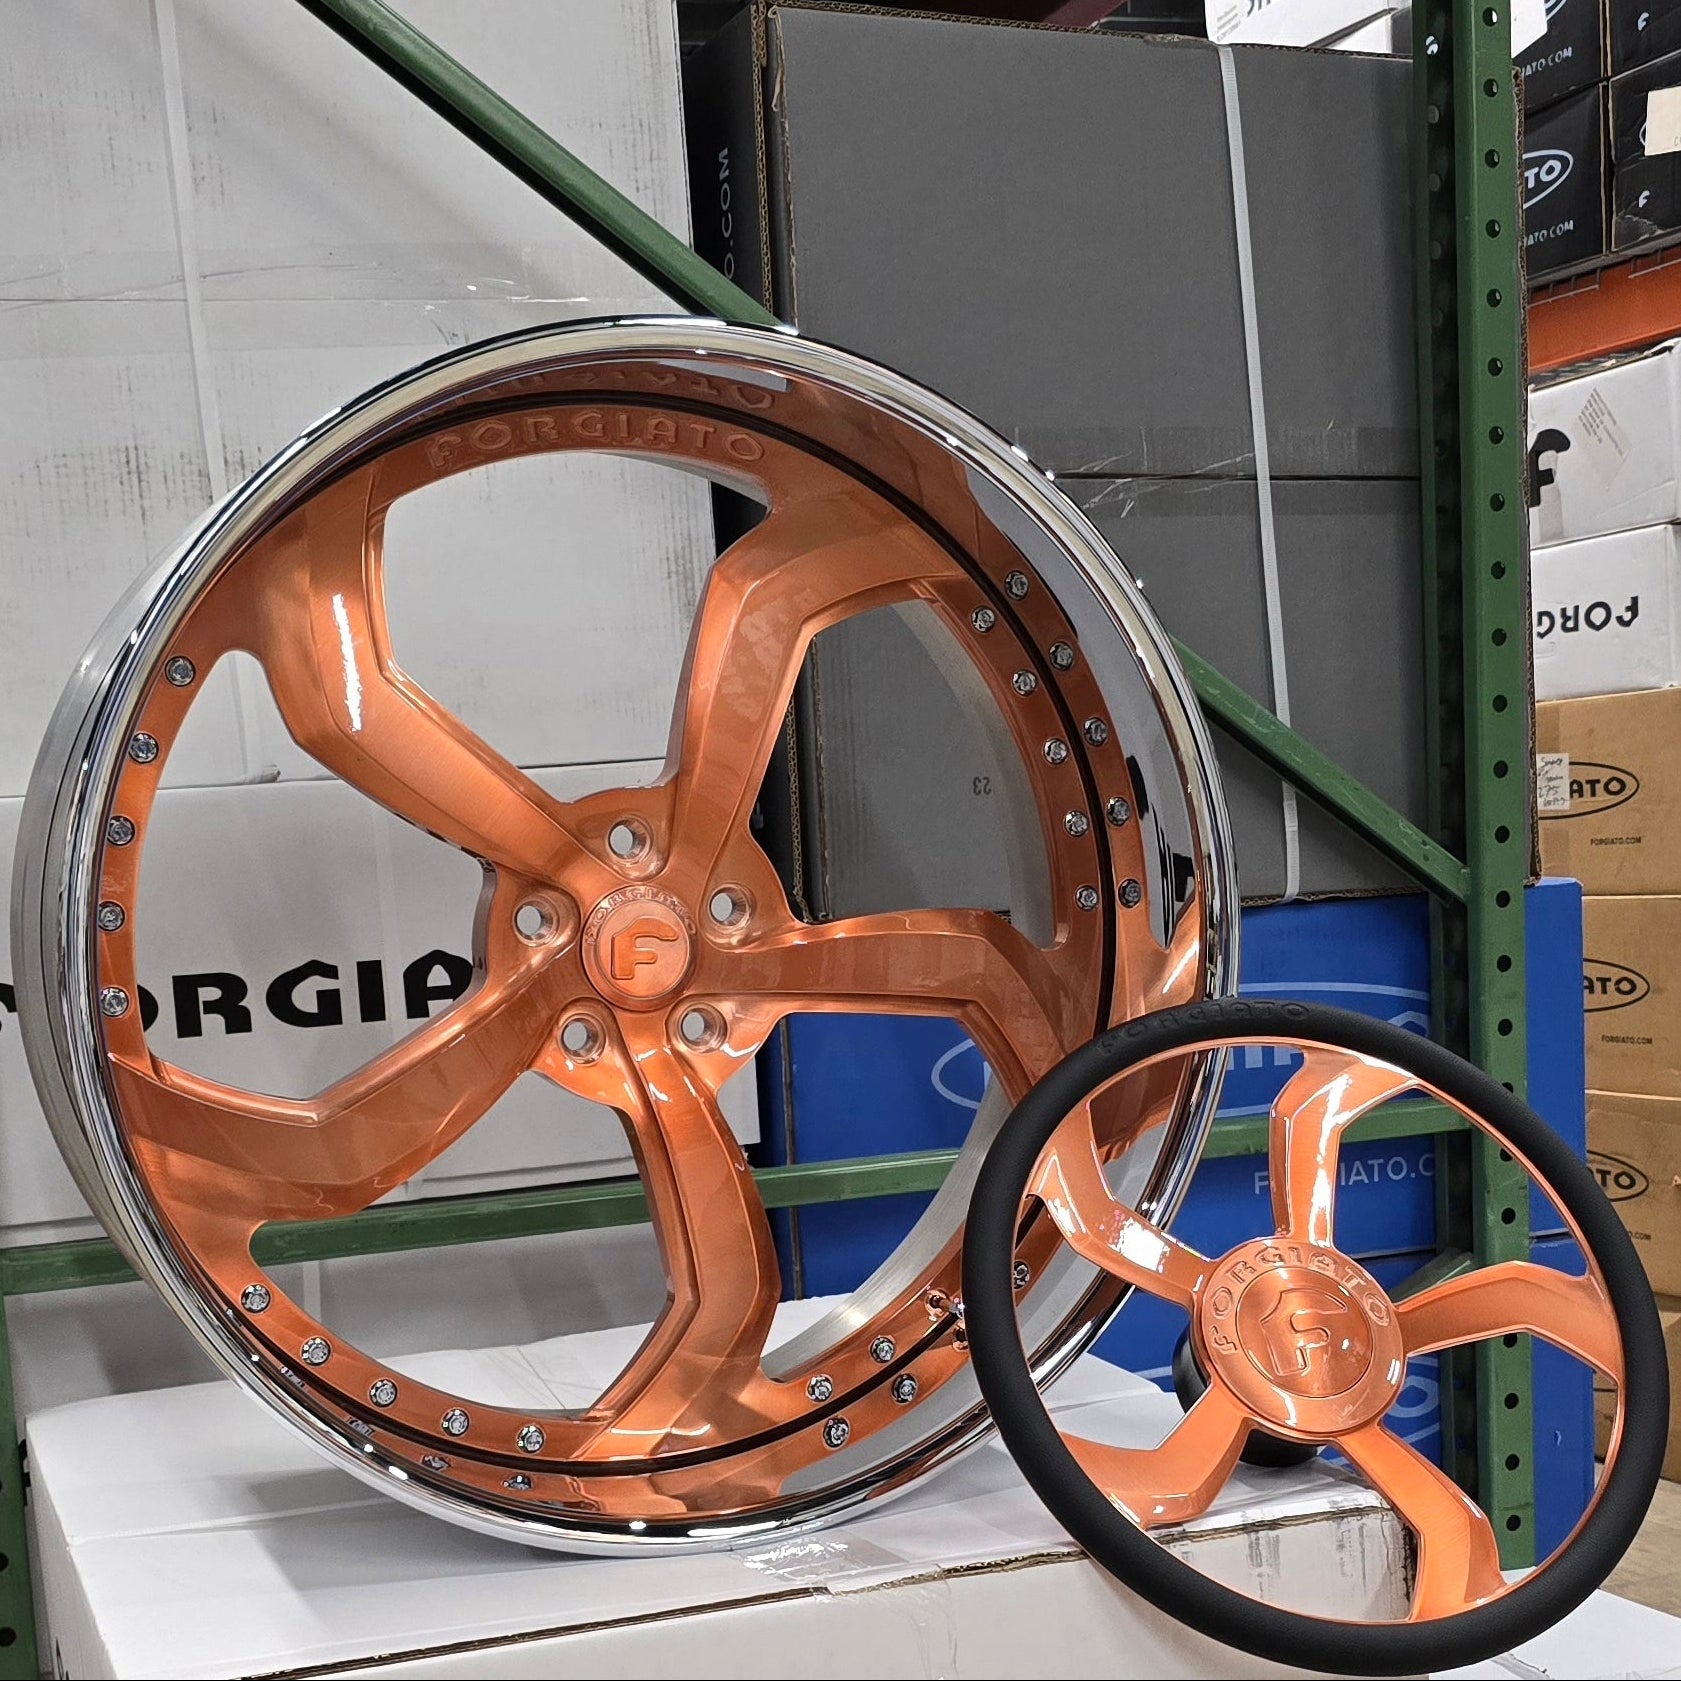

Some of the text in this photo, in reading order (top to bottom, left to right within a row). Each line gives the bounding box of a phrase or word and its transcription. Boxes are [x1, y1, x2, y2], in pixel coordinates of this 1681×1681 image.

[426, 408, 766, 469] FORGIATO
[1536, 595, 1639, 639] FORG
[584, 886, 696, 945] FORGIATO
[1097, 1000, 1311, 1056] FORGIATO
[1211, 1246, 1391, 1355] FORGIATO
